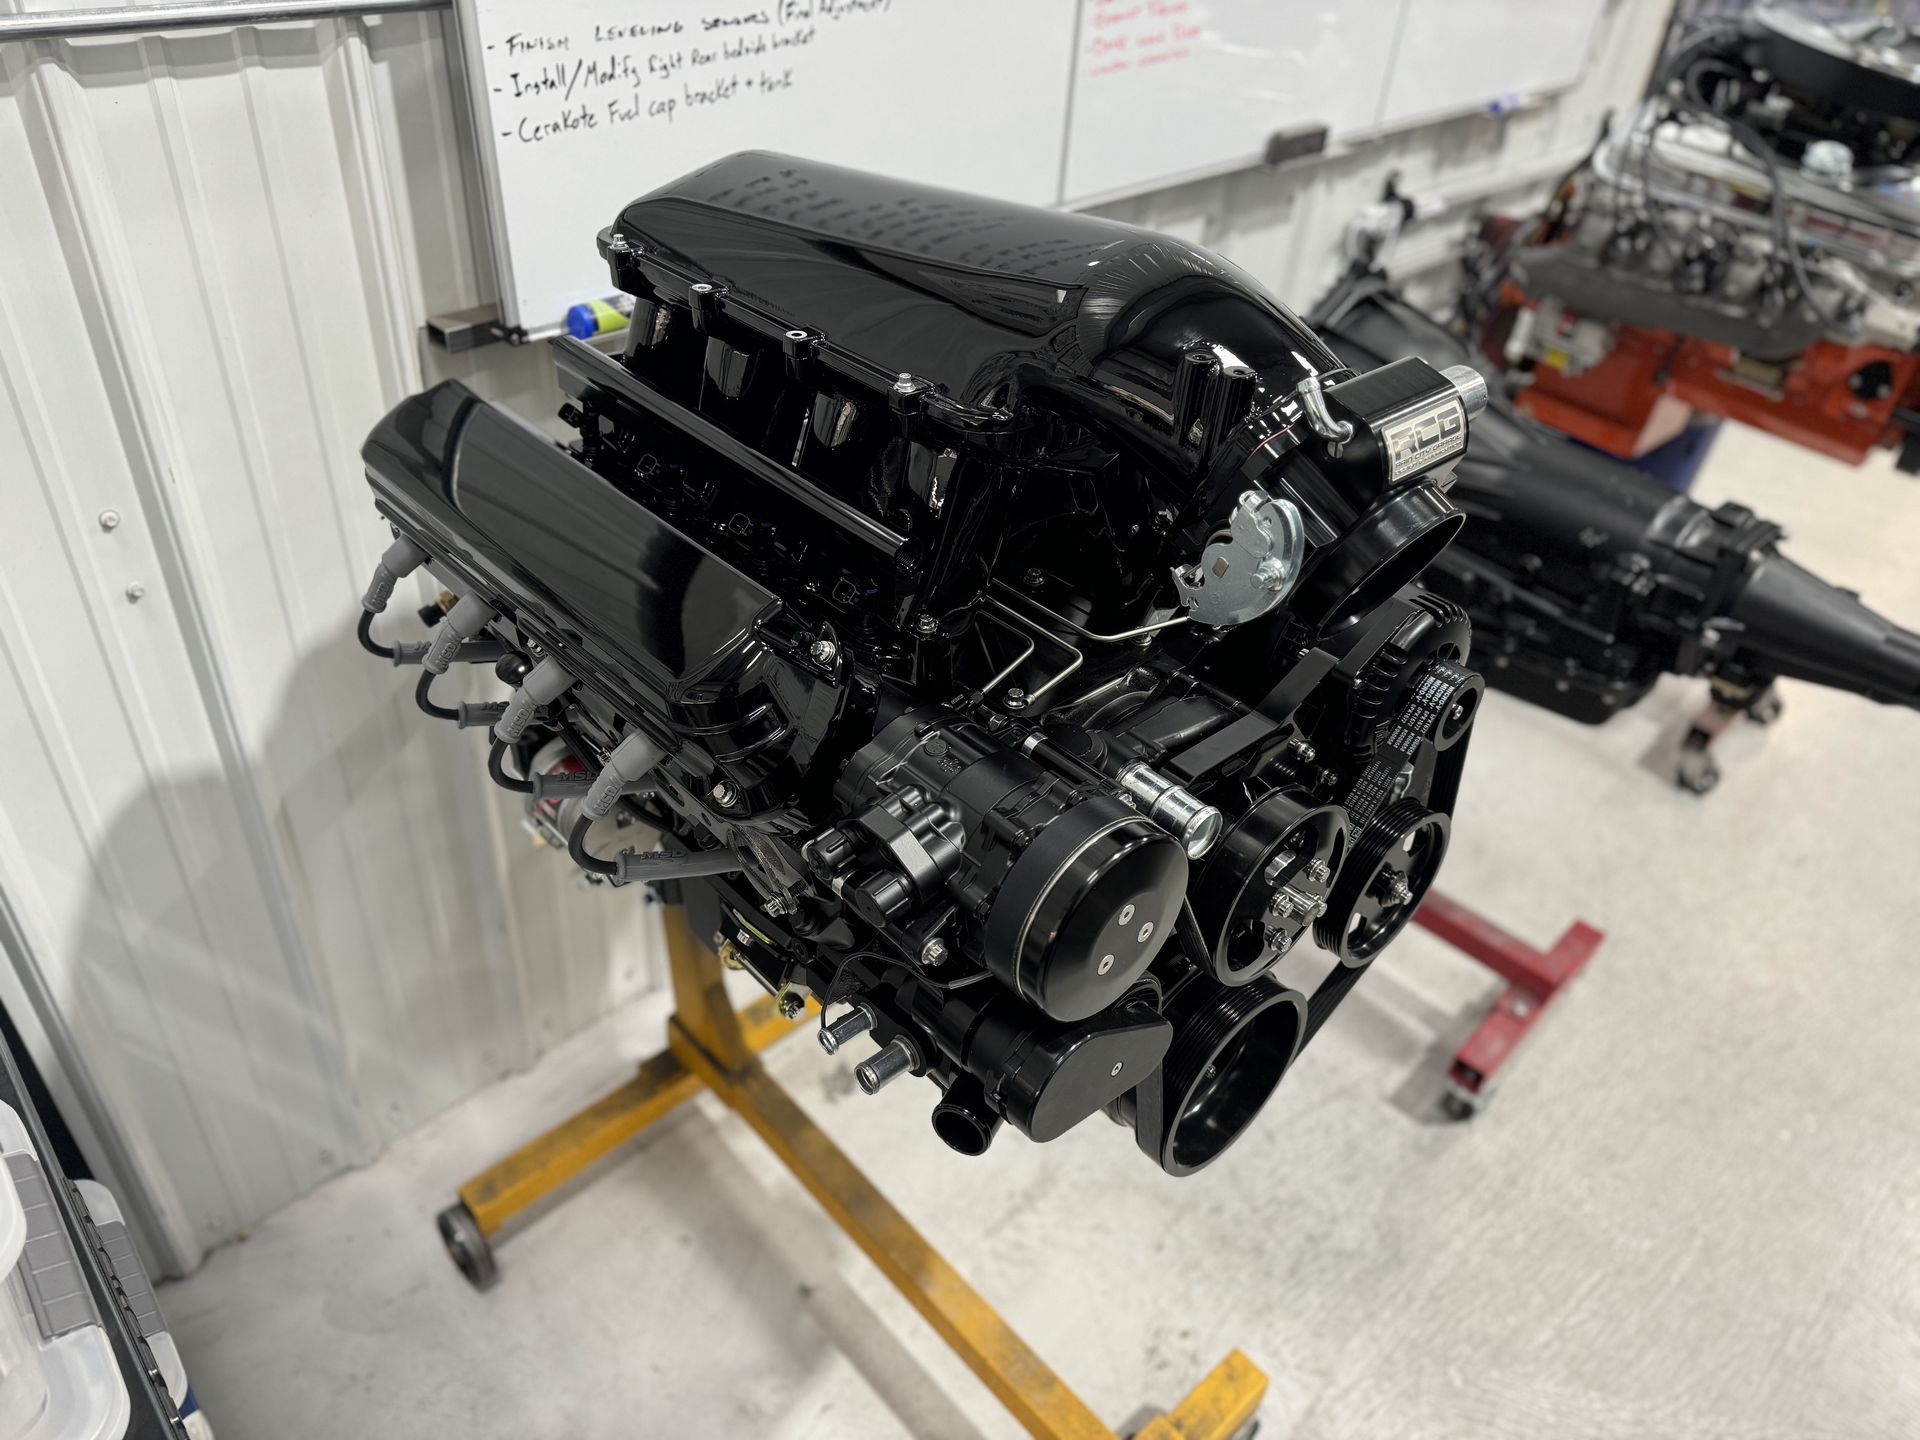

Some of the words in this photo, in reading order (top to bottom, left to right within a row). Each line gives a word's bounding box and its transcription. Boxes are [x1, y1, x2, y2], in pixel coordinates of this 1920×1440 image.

[595, 20, 684, 42] LEVELING
[608, 93, 639, 124] Fuel
[648, 98, 677, 123] cap
[1390, 405, 1461, 461] RCG
